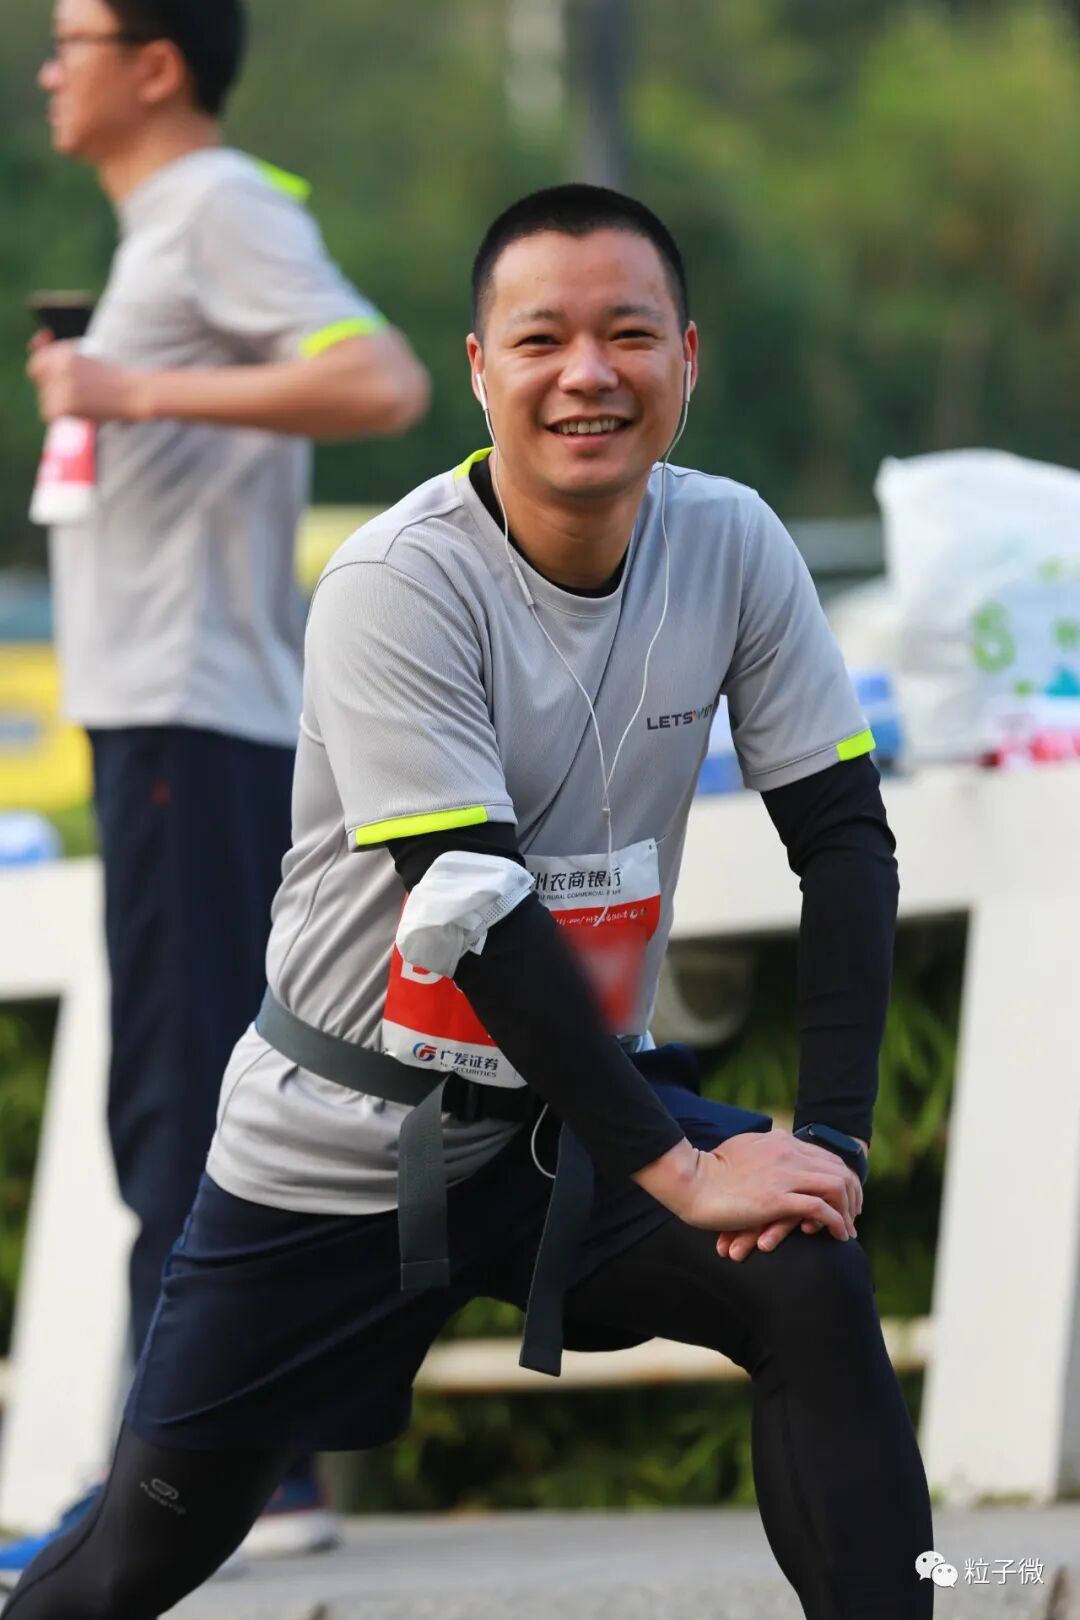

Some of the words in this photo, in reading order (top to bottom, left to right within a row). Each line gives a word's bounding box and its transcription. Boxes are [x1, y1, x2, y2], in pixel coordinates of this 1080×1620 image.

[567, 890, 604, 899] COMMERCIAL
[440, 1050, 498, 1071] 广发证券
